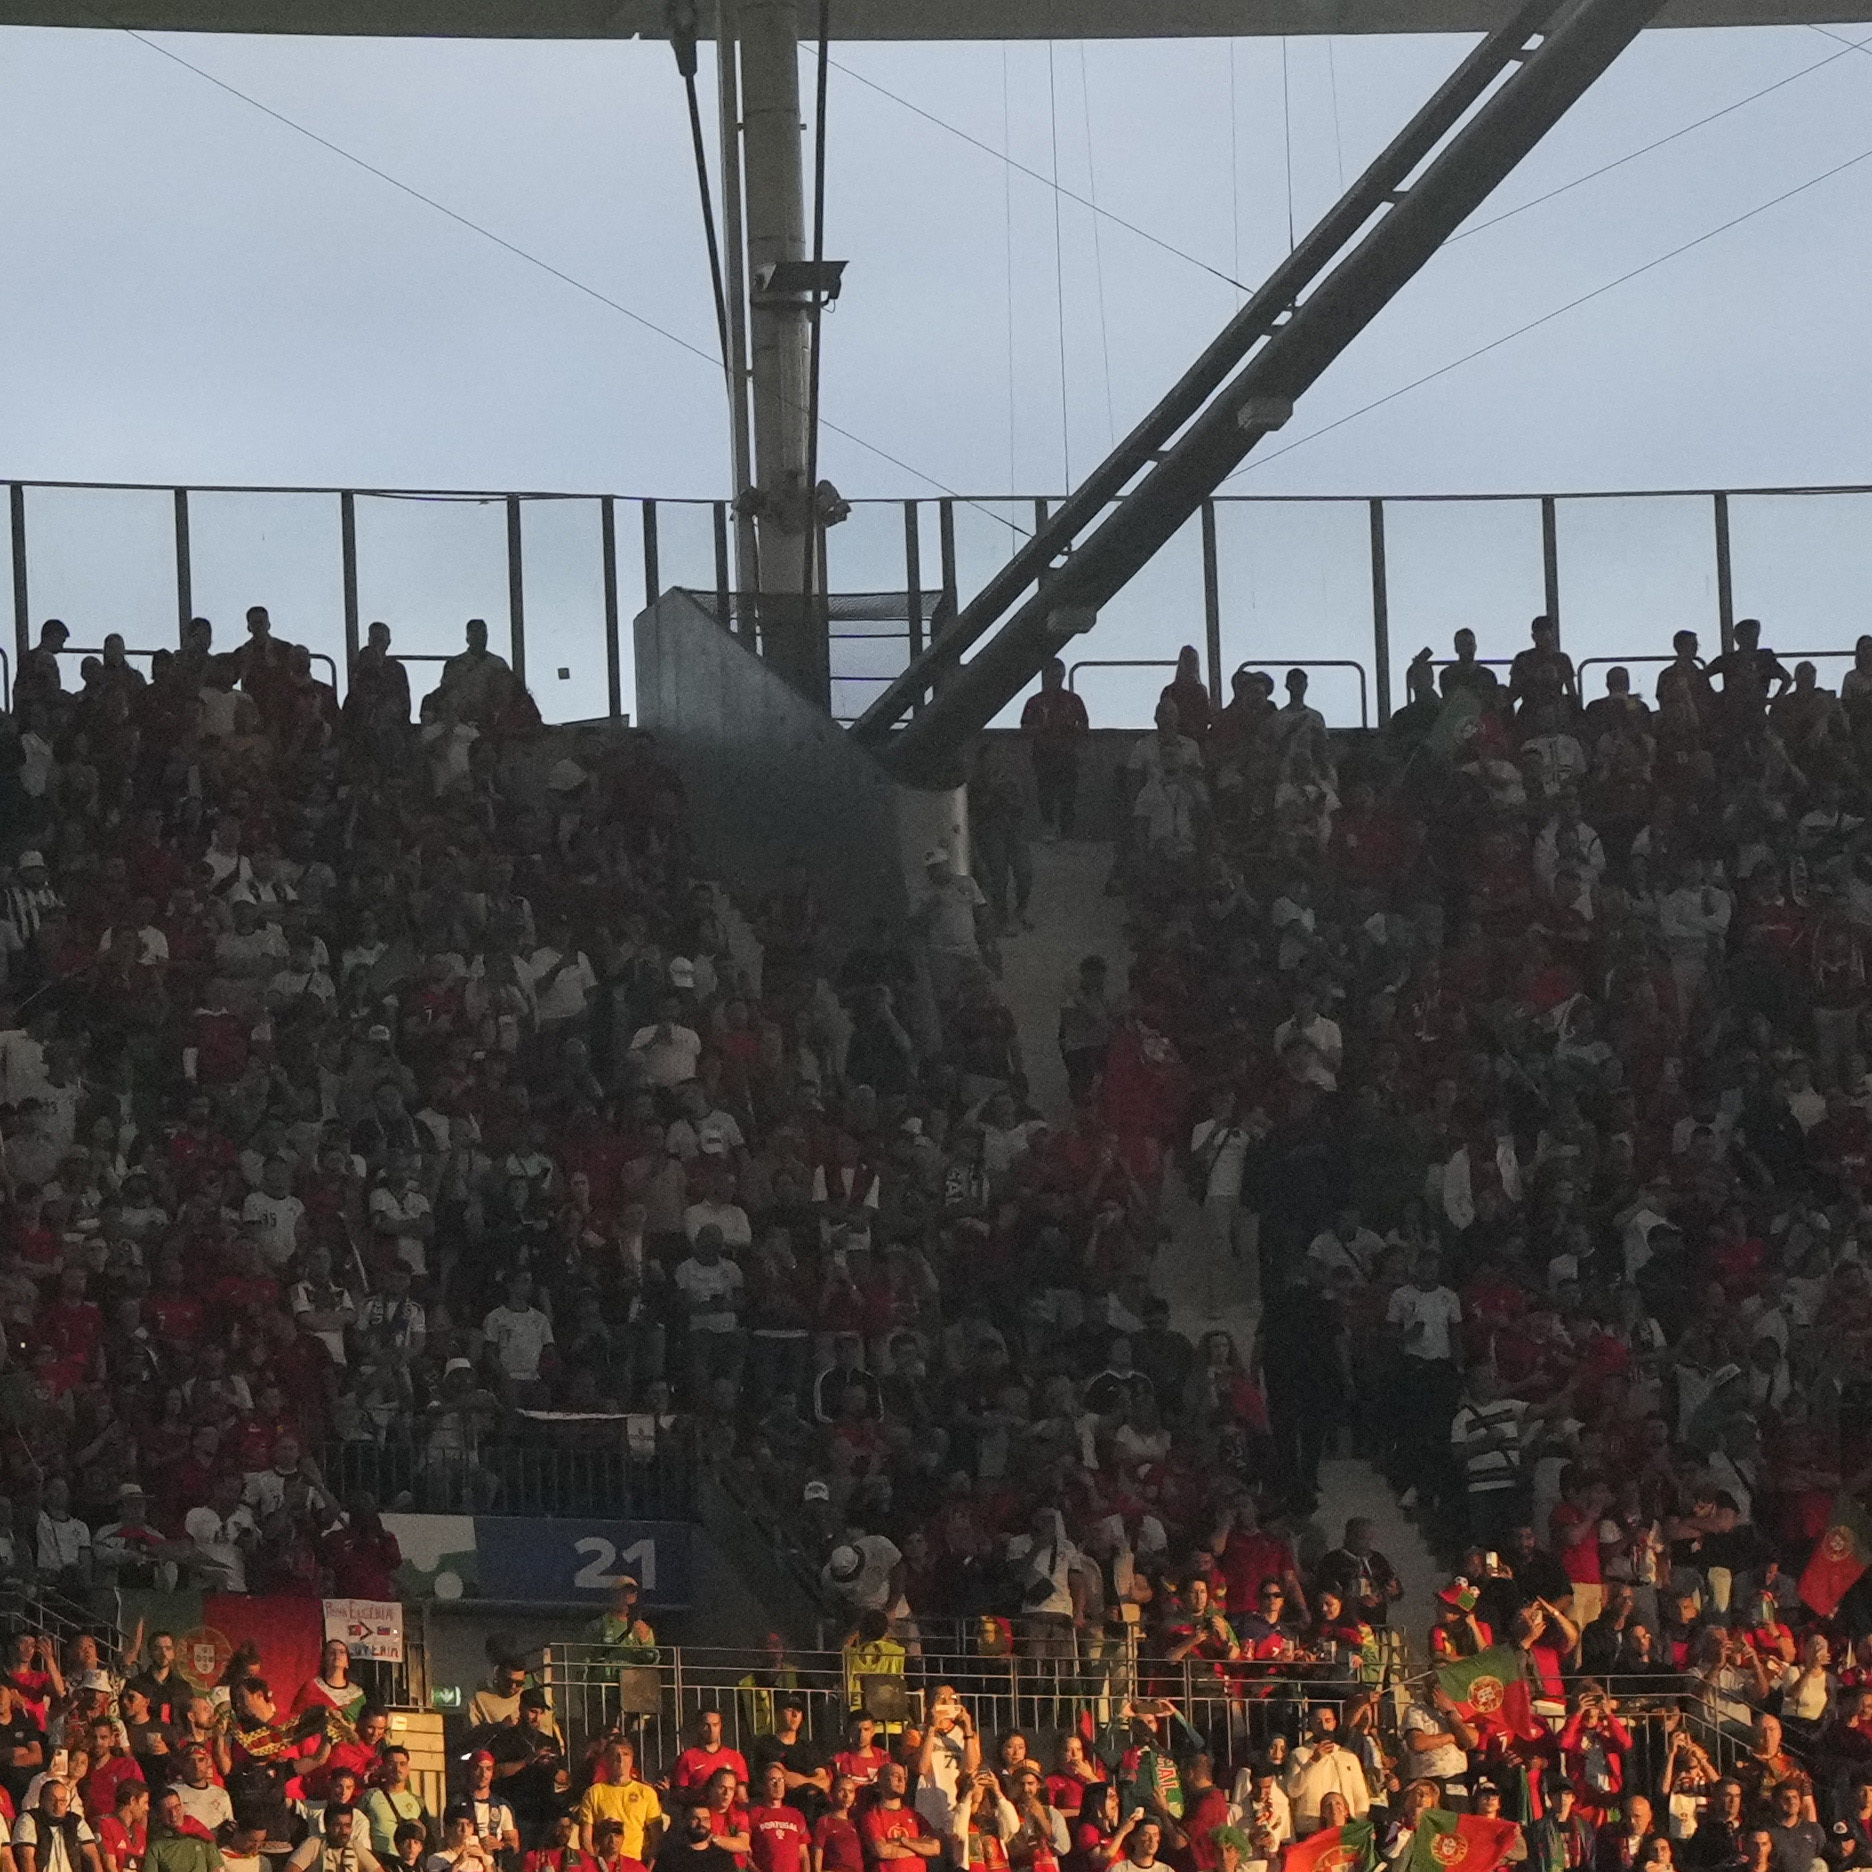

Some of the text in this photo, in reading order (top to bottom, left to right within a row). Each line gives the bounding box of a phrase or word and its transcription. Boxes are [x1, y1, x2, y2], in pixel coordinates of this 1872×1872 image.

[574, 1536, 657, 1589] 21
[1498, 1735, 1508, 1753] 7
[759, 1821, 799, 1833] PORTUGAL
